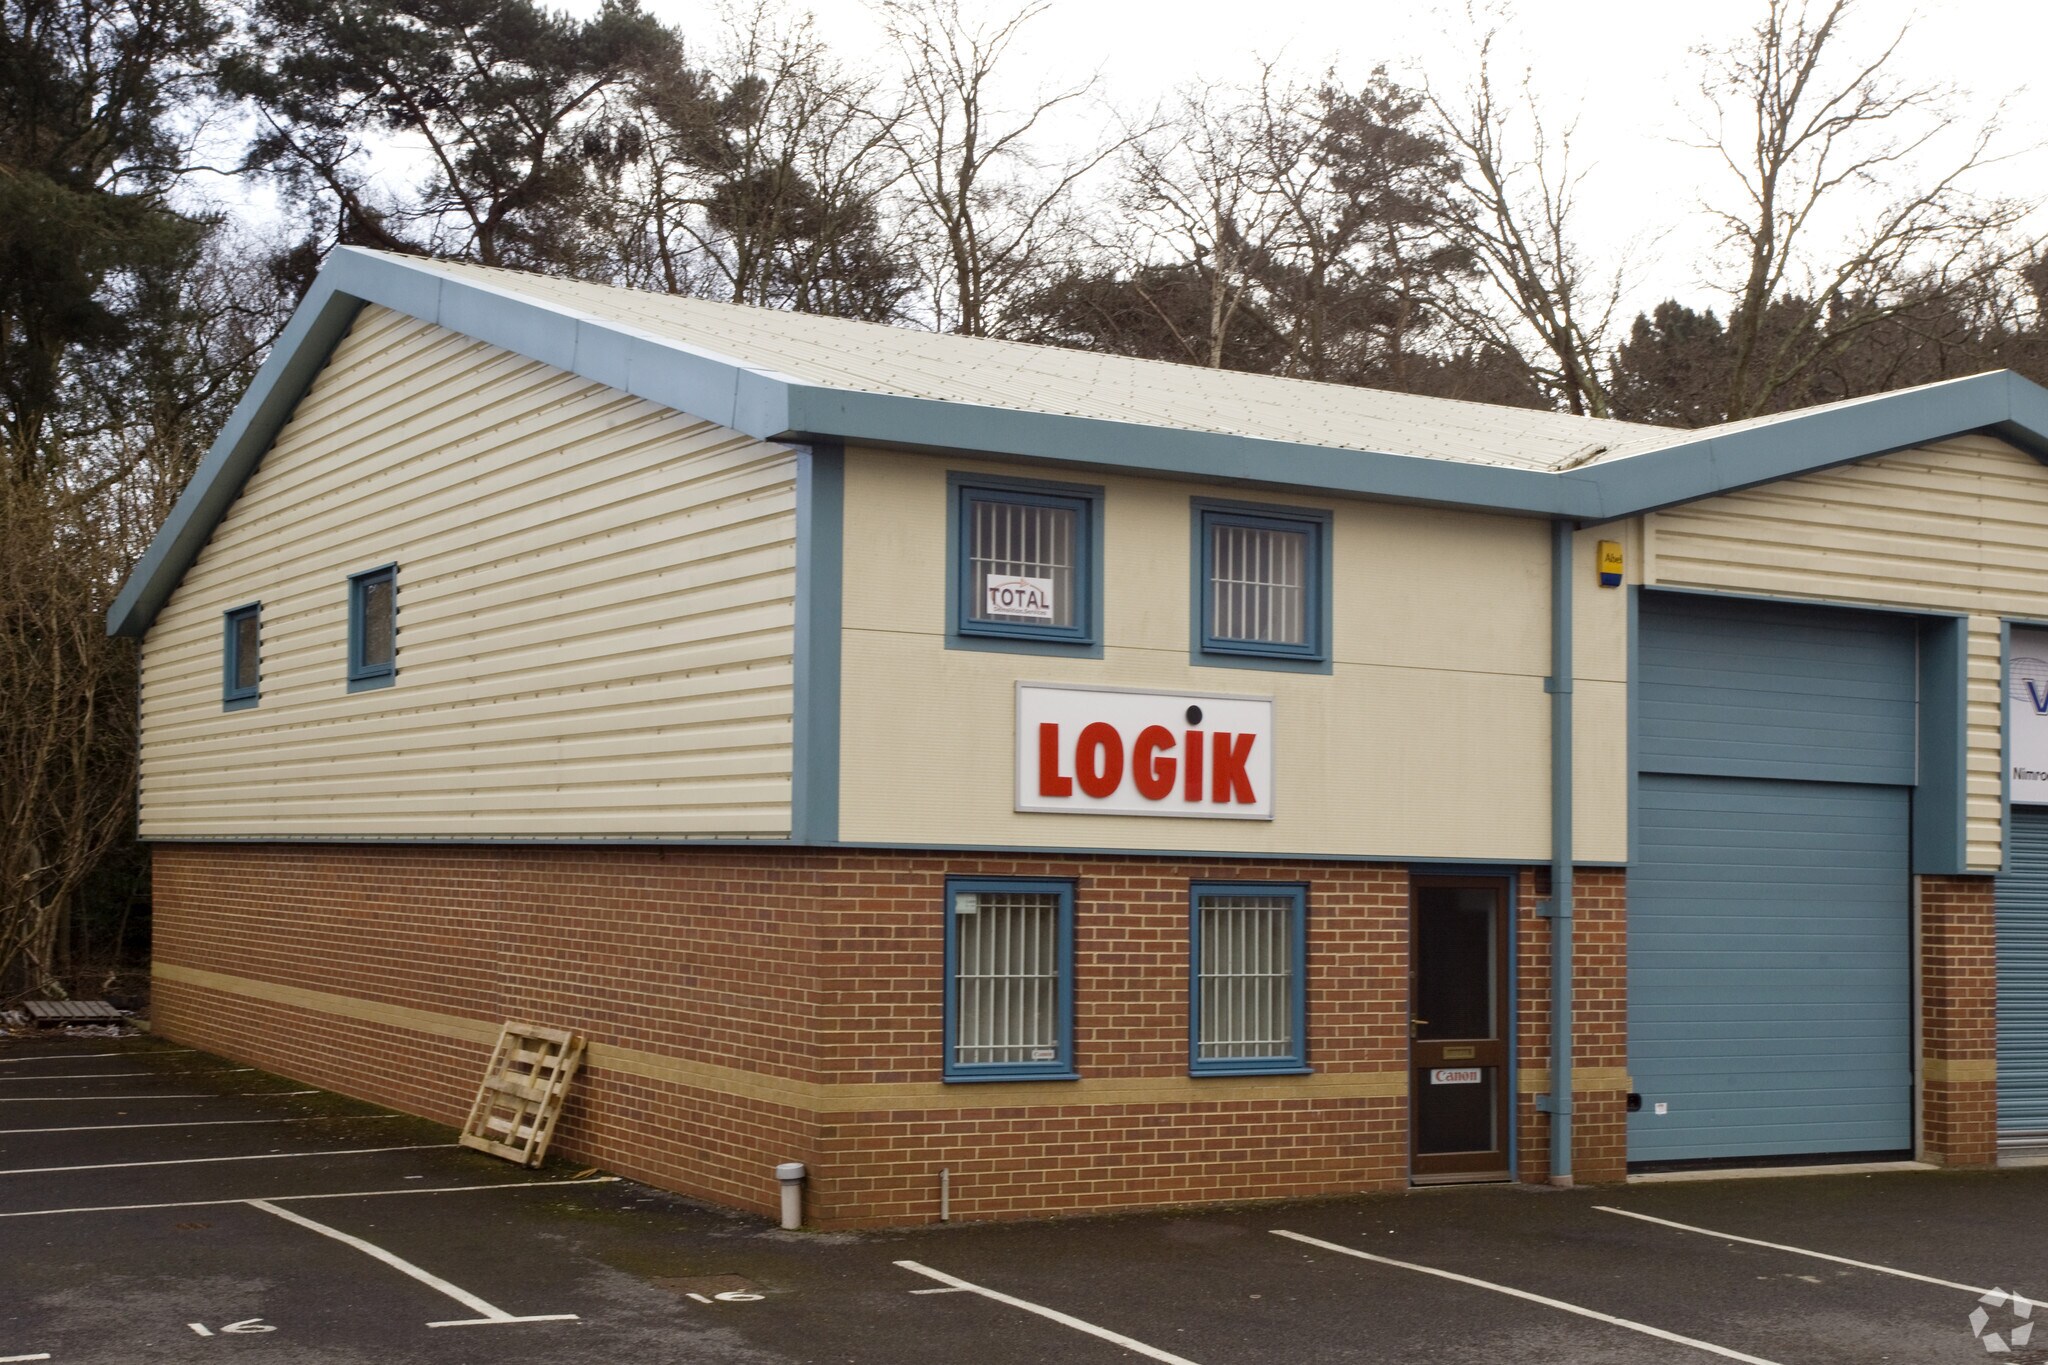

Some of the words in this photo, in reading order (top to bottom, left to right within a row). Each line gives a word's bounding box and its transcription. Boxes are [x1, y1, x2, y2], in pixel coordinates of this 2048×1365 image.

[989, 587, 1049, 610] TOTAL
[2013, 767, 2048, 781] Nimro
[1436, 1071, 1477, 1082] Canon
[187, 1318, 278, 1337] 16
